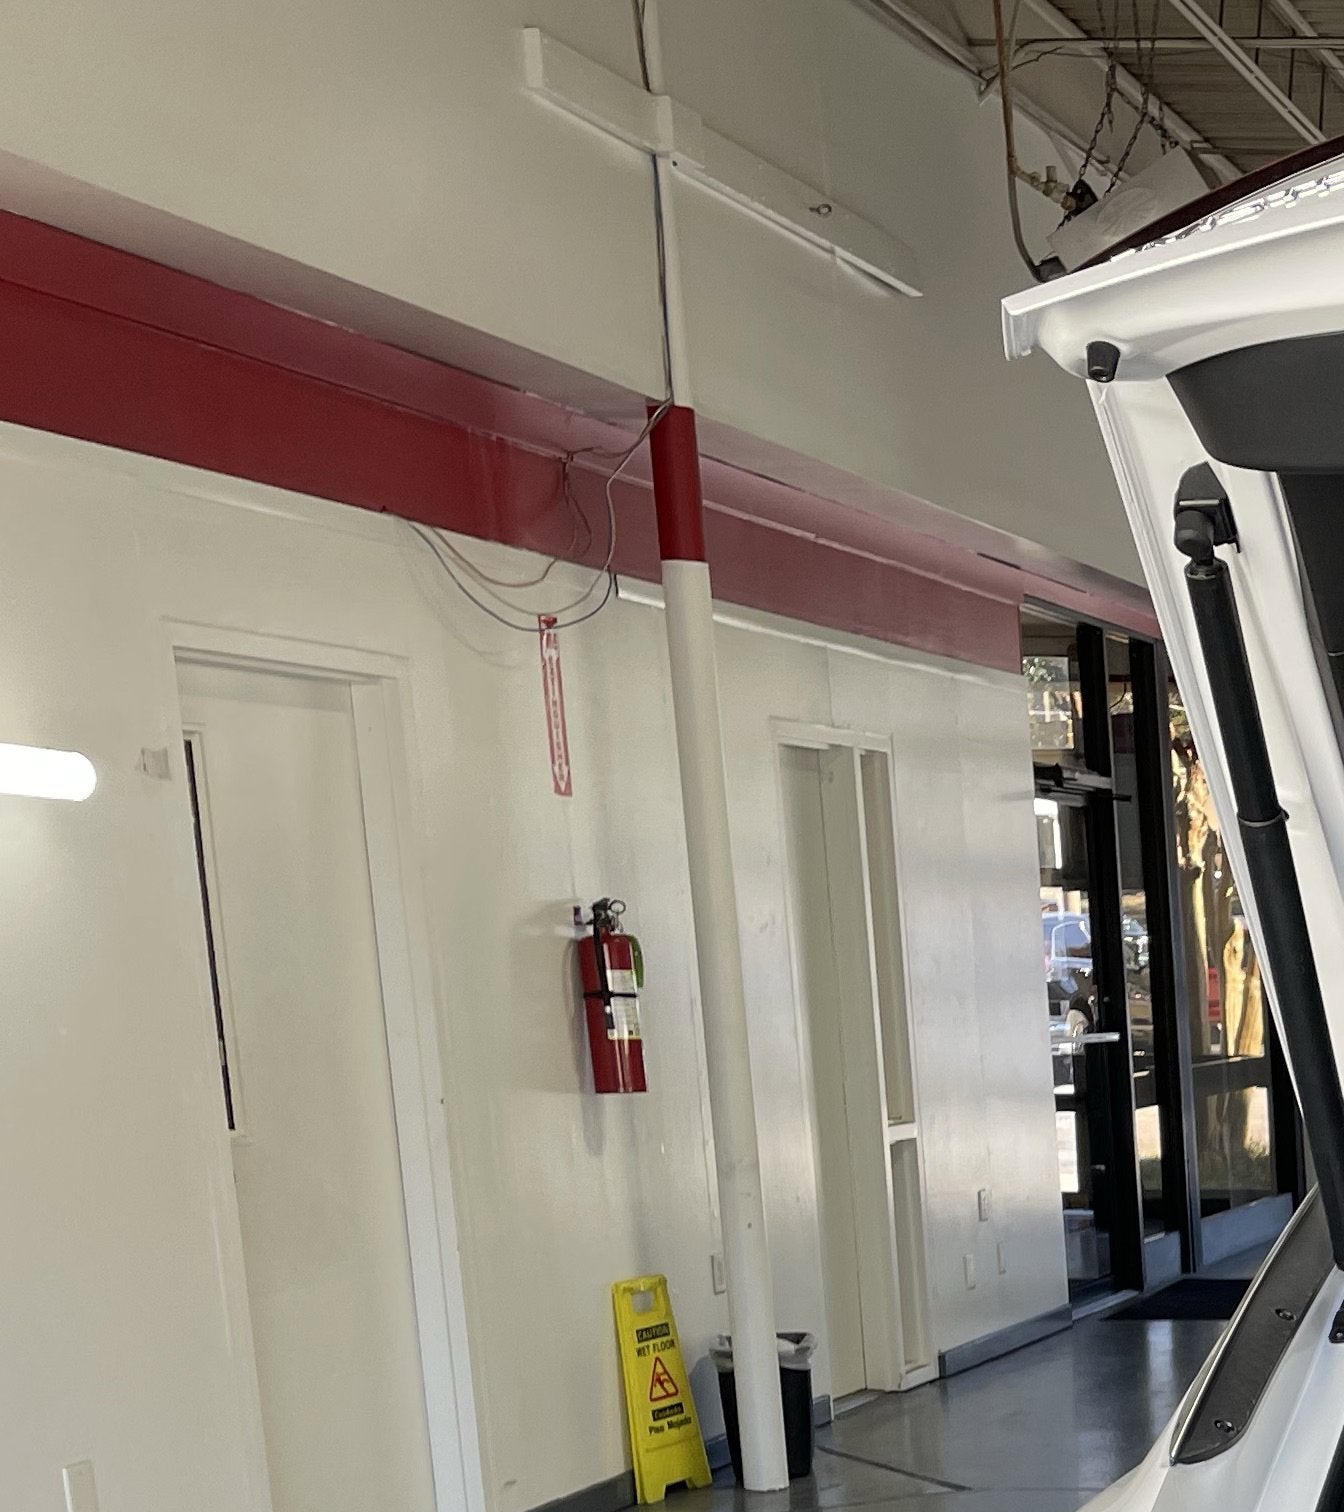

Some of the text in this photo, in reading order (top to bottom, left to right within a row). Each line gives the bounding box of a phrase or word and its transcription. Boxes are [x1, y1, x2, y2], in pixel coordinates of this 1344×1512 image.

[637, 1325, 669, 1341] CAUTION
[636, 1339, 675, 1357] WET FLOOR
